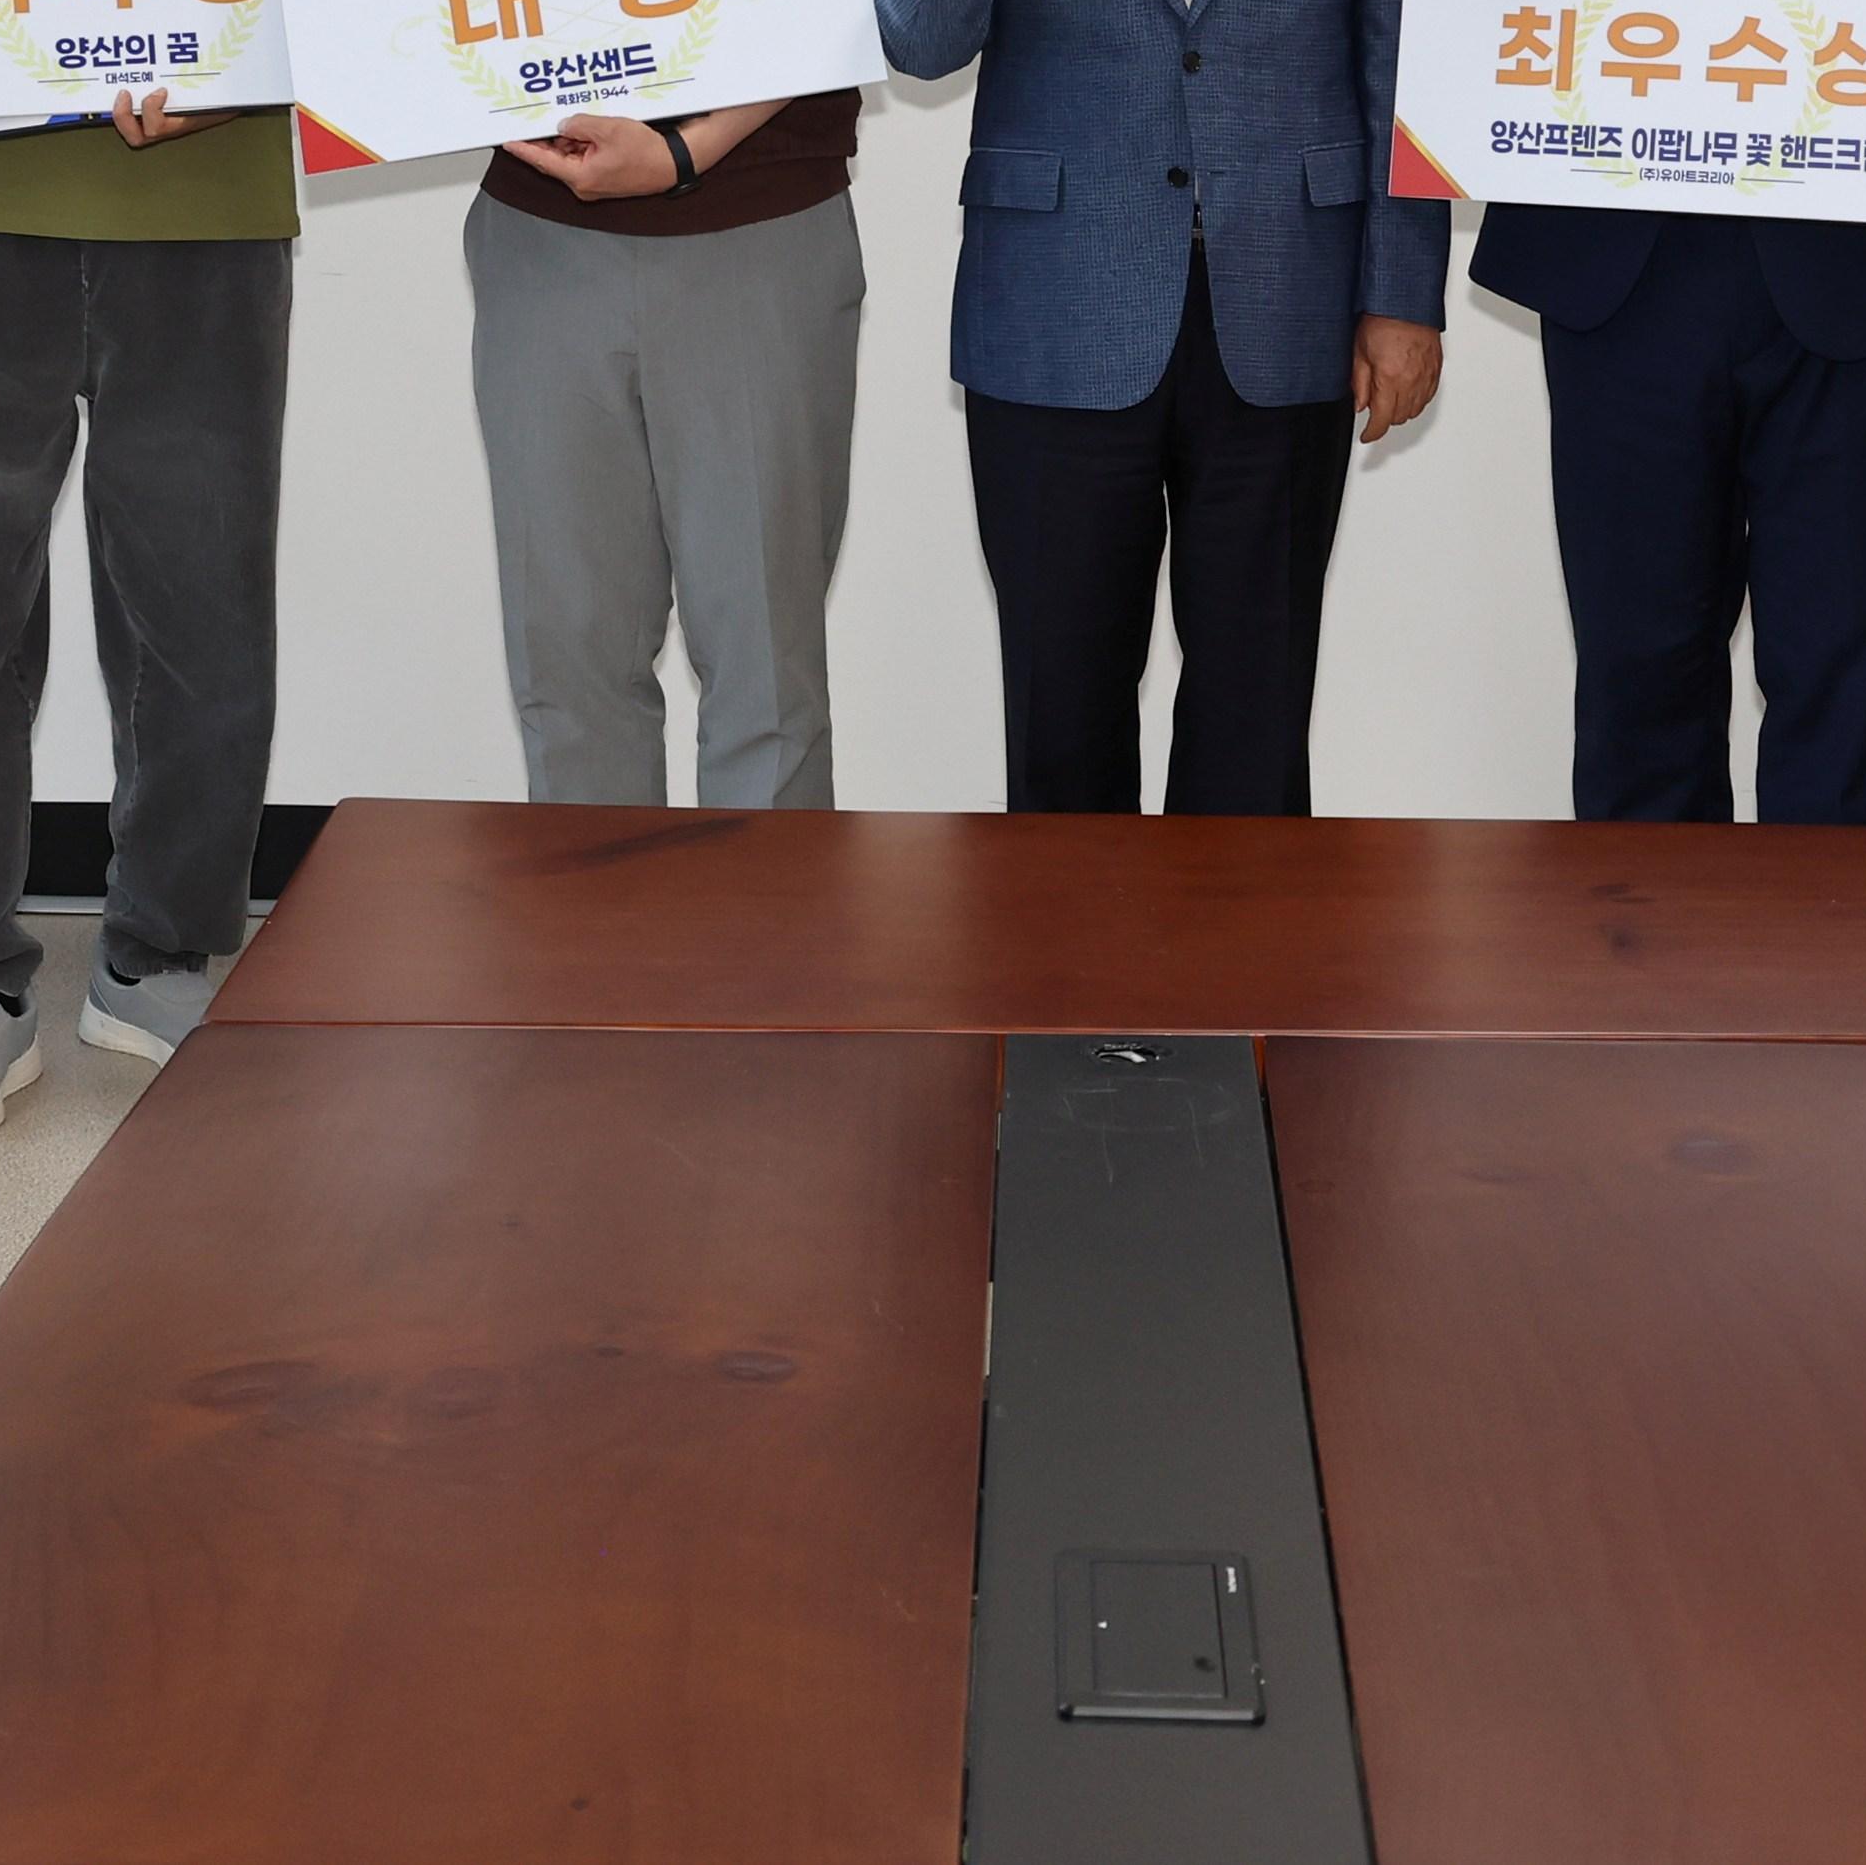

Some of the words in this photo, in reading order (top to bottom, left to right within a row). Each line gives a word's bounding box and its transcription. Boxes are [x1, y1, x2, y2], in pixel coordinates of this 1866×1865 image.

[55, 34, 156, 69] 양산의
[167, 32, 199, 64] 꿈
[519, 44, 656, 93] 양산샌드
[106, 72, 153, 84] 대석도예
[1491, 121, 1622, 158] 양산프렌즈
[1632, 128, 1737, 165] 이팝나무
[1746, 133, 1772, 166] 꽃
[1640, 168, 1734, 185] (주)유아트코리아
